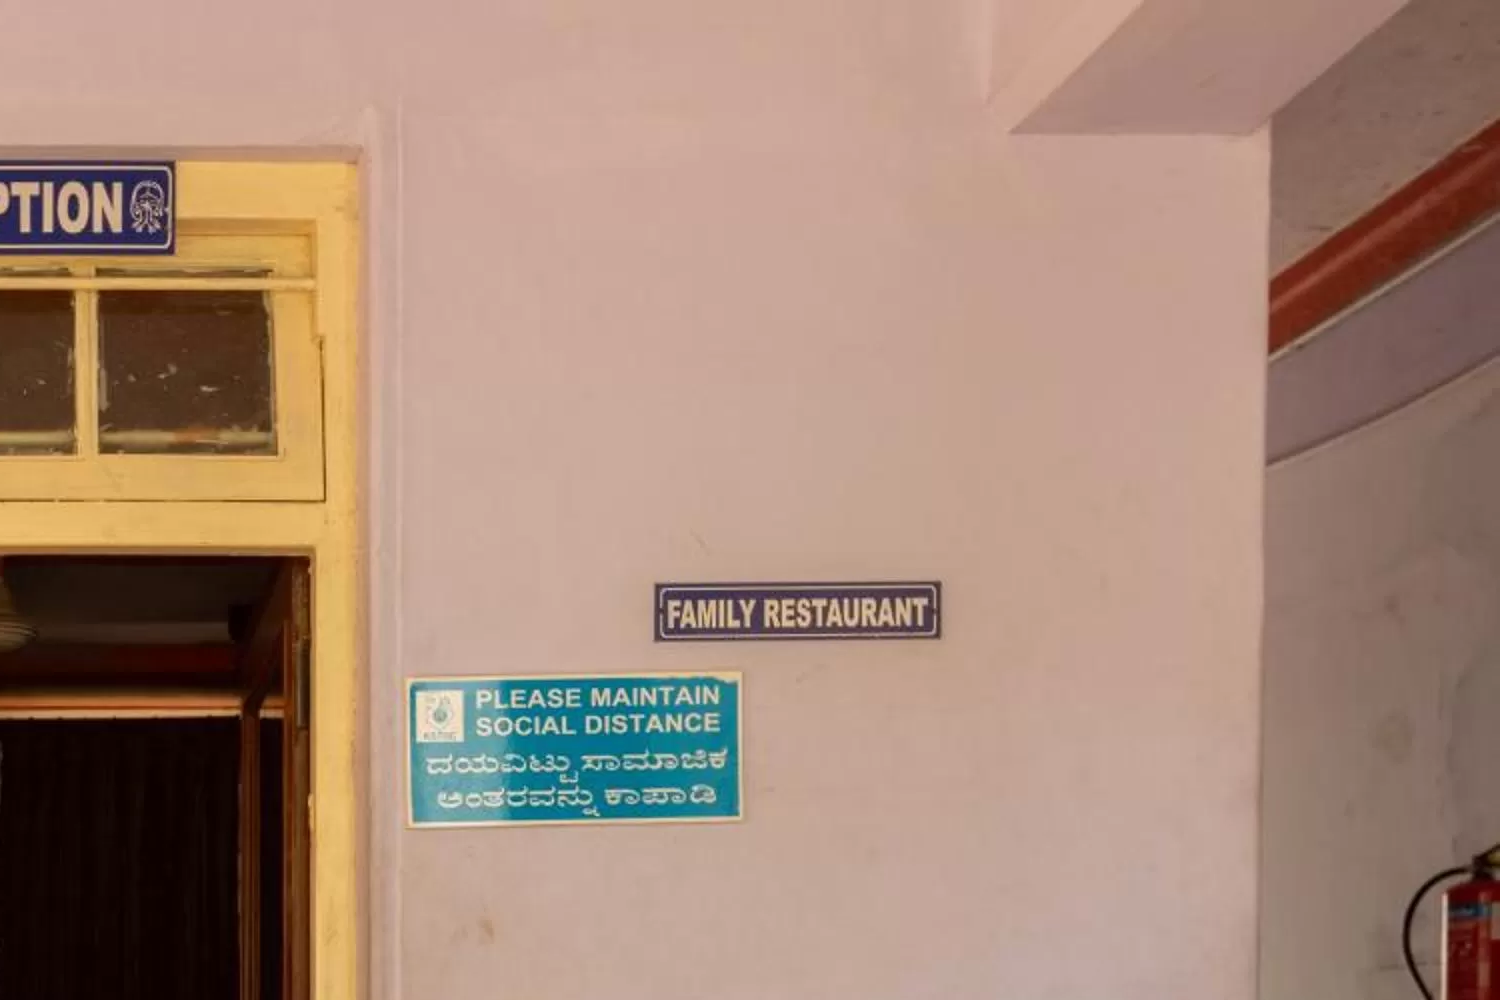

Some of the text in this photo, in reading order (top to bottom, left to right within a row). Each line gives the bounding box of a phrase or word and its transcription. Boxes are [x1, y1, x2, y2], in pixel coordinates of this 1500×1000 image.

[666, 596, 930, 629] FAMILY RESTAURANT
[475, 685, 721, 709] PLEASE MAINTAIN
[475, 714, 577, 737] SOCIAL
[584, 712, 721, 734] DISTANCE
[426, 747, 728, 783] ದಯವಿಟ್ಟು ಸಾಮಾಜಿಕ
[437, 783, 717, 817] ಅಂತರವನ್ನು ಕಾಪಾಡಿ
